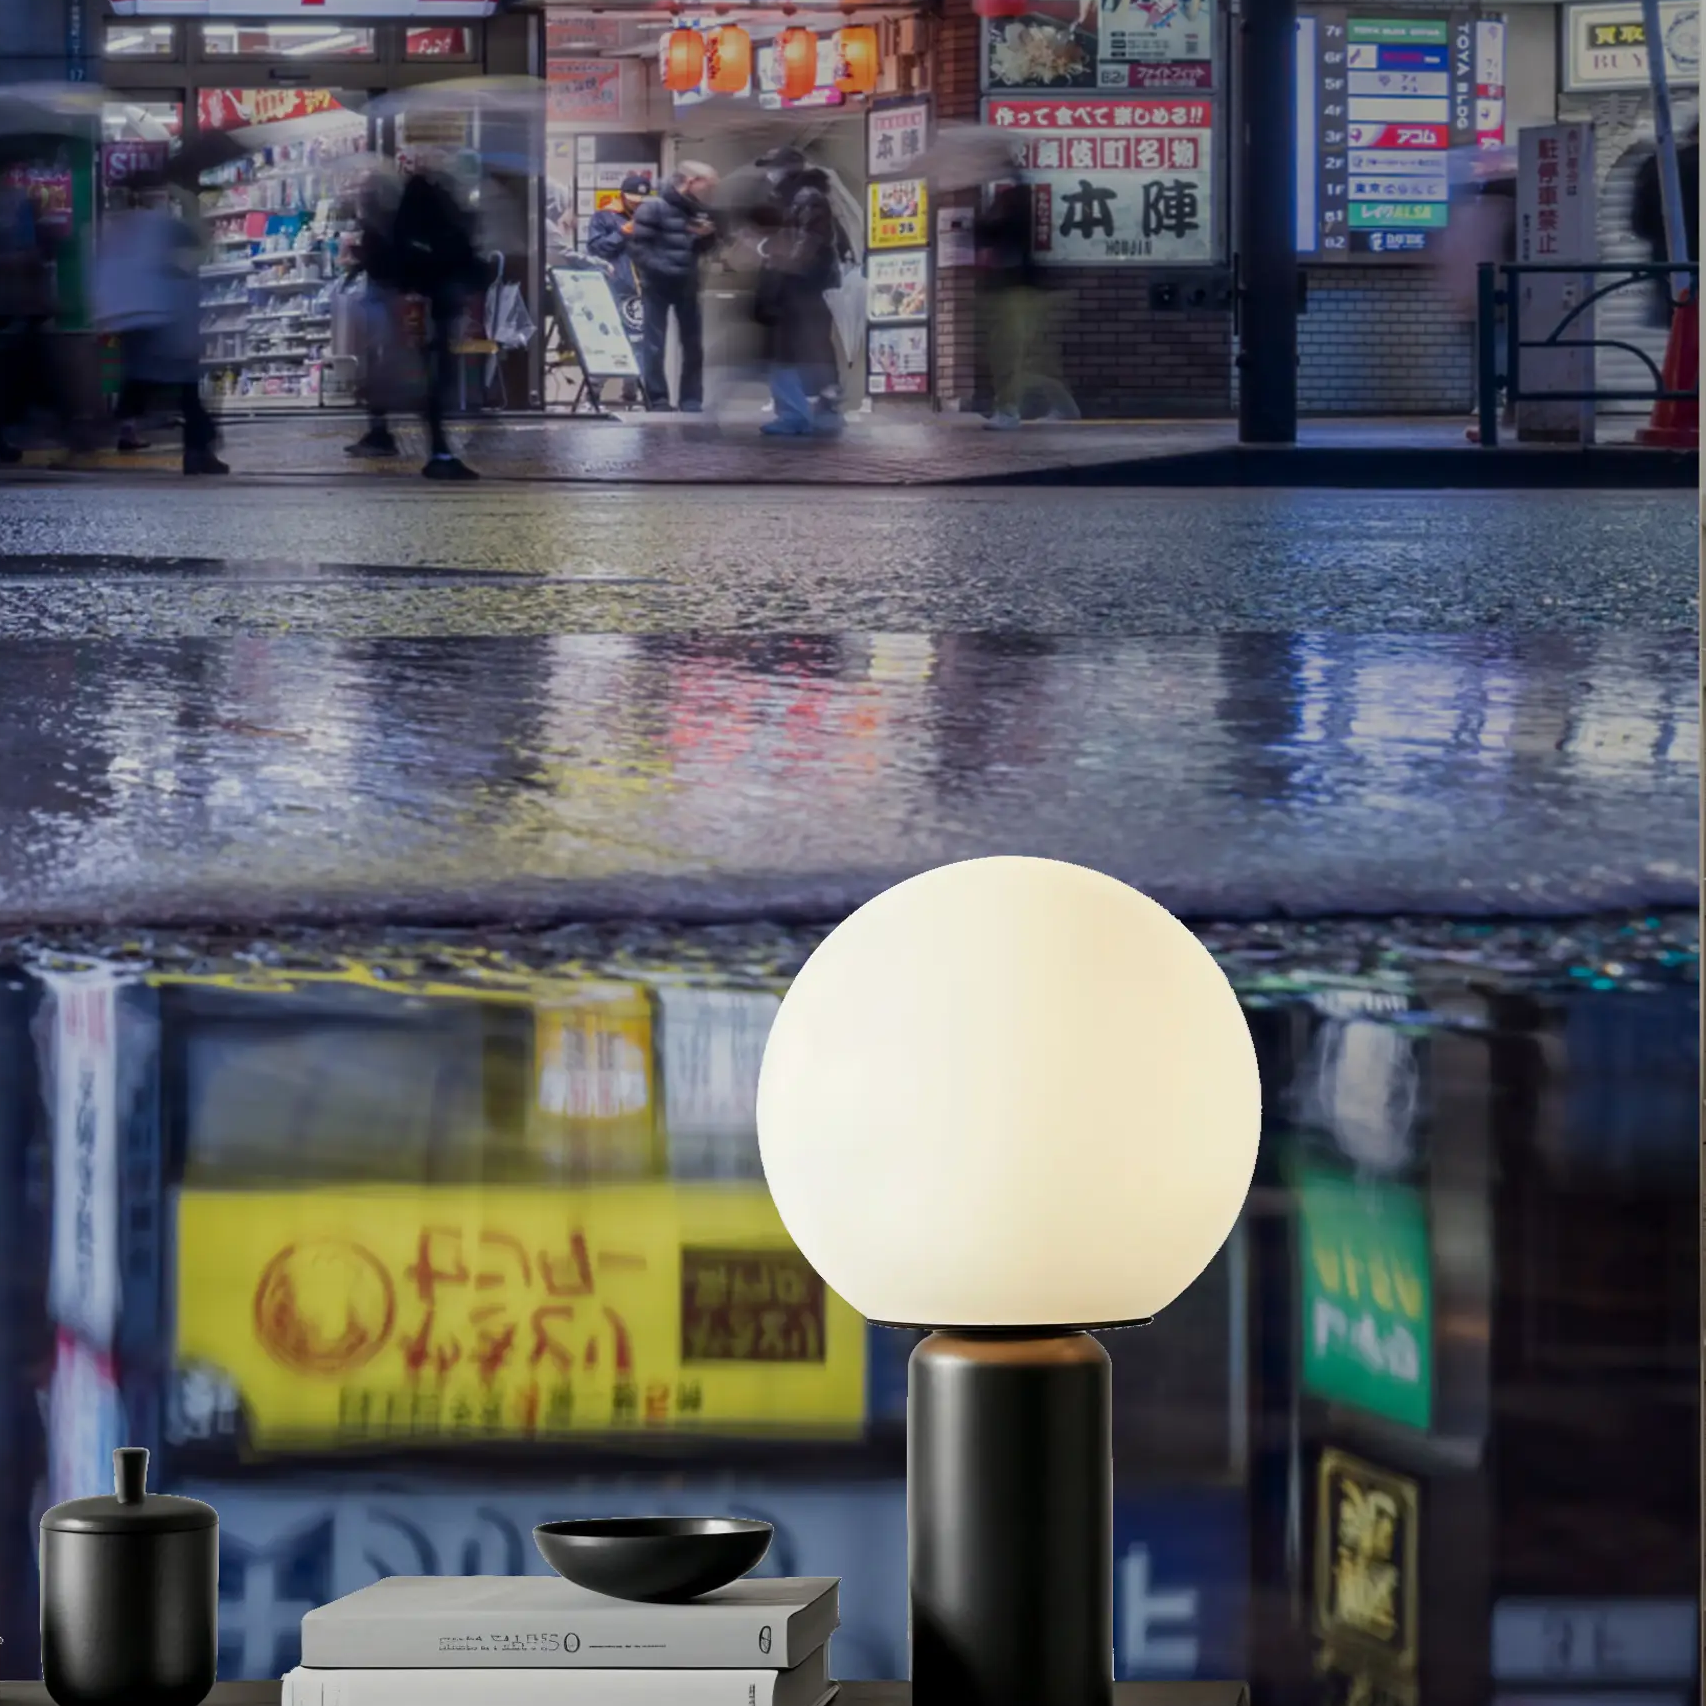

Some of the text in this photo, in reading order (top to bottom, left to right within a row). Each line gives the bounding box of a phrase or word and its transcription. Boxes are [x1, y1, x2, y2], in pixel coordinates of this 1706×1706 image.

[1594, 26, 1645, 45] 買取
[1456, 24, 1471, 77] TOYA
[1136, 67, 1206, 79] ファイトフィット
[994, 106, 1203, 125] 作って 食べて 楽しめる!!
[875, 133, 920, 160] 本陣
[1396, 129, 1437, 145] アコム
[1537, 138, 1560, 255] 駐停車禁止
[1059, 178, 1200, 239] 本陣
